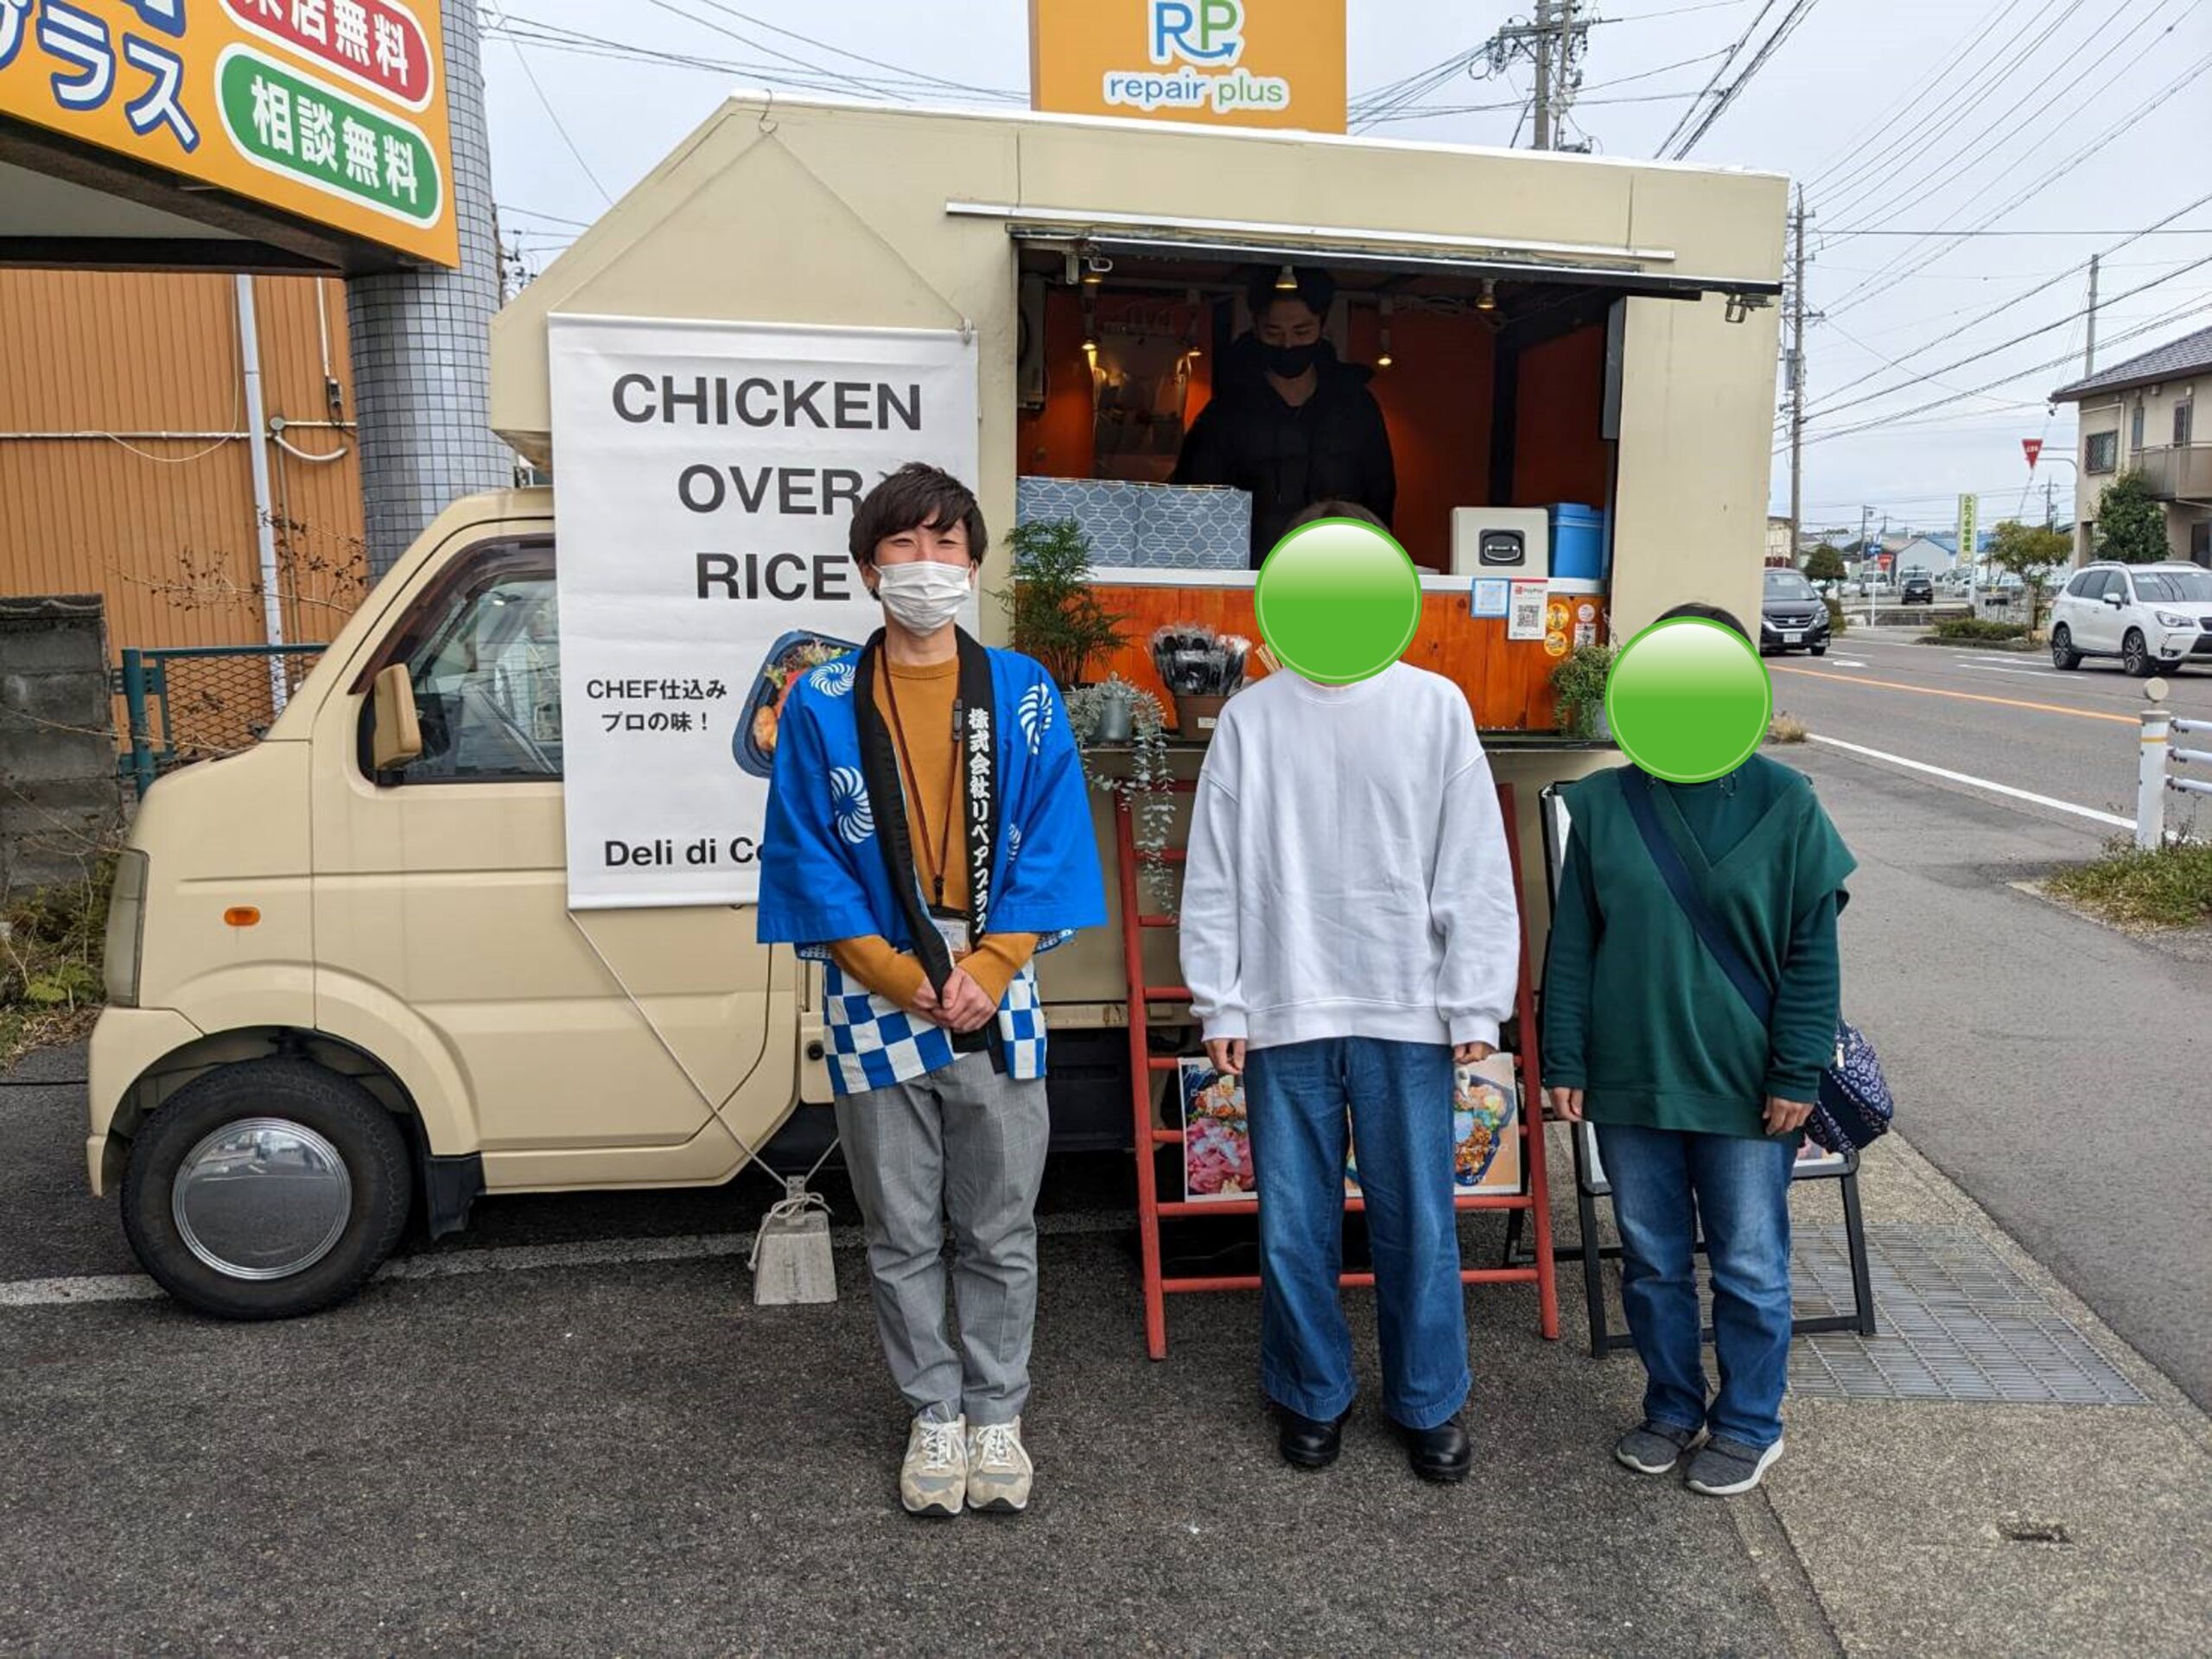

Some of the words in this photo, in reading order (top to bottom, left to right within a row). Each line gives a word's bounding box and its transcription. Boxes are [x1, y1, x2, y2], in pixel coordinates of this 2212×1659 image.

[1110, 74, 1205, 102] repair
[1217, 75, 1283, 106] plus
[251, 74, 418, 205] 相談無料
[613, 373, 921, 430] CHICKEN
[678, 463, 864, 516] OVER
[696, 552, 851, 601] RICE
[586, 679, 728, 701] CHEF仕込み
[601, 711, 708, 733] プロの味！
[605, 839, 672, 867] Deli
[685, 838, 716, 865] di
